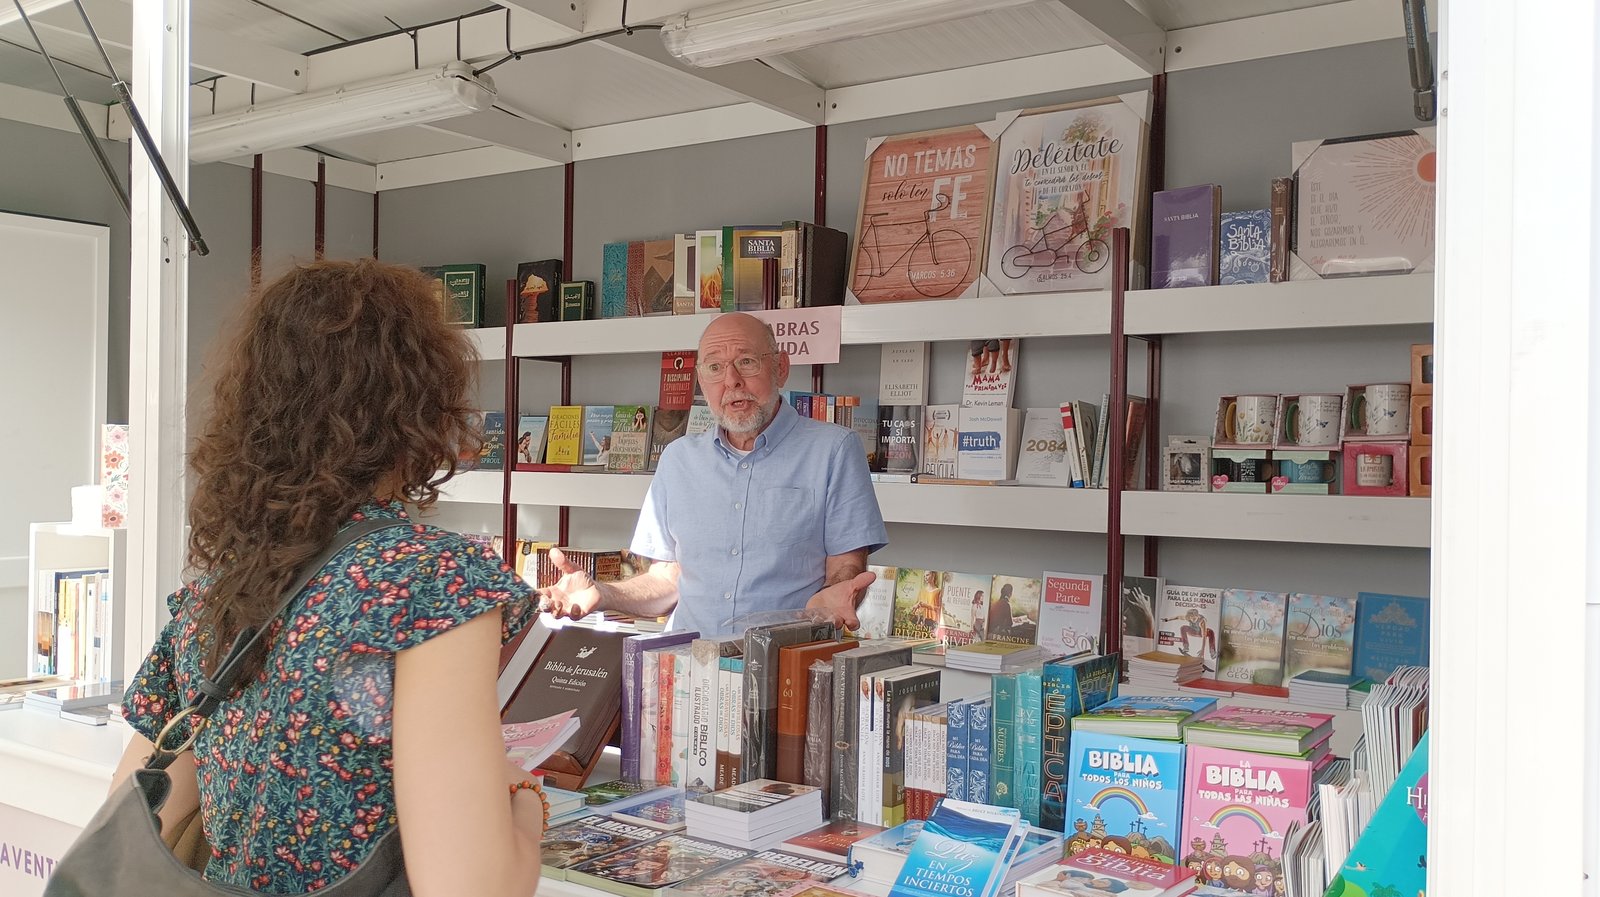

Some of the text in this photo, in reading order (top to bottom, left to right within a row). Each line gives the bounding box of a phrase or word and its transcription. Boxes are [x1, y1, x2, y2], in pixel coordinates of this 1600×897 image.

[884, 144, 976, 178] NO TEMAS
[1011, 136, 1123, 175] Deléitate
[929, 175, 972, 223] FE
[1180, 212, 1199, 221] BIBLIA
[882, 420, 893, 428] TU
[895, 427, 903, 436] SÍ
[881, 436, 916, 444] IMPORTA
[962, 435, 996, 447] #truth
[1026, 439, 1068, 452] 2084
[609, 461, 643, 470] GEORGE
[1048, 578, 1089, 592] Segunda
[947, 586, 972, 599] PUENTE
[1055, 592, 1080, 604] Parte
[1175, 601, 1207, 609] DECISIONES
[1193, 597, 1215, 605] BUENAS
[1224, 604, 1273, 632] Dios
[898, 623, 932, 633] FRANCINE
[1288, 610, 1342, 639] Dios
[895, 628, 936, 640] RIVERS
[993, 634, 1030, 644] FRANCINE
[544, 661, 567, 673] Biblia
[571, 664, 608, 679] Jerusalén
[551, 676, 587, 687] Quinta Edición
[1043, 681, 1071, 689] BIBLIA
[783, 688, 793, 698] 60
[693, 686, 702, 724] ILUSTRADO
[699, 678, 710, 767] DICCIONARIO BÍBLICO
[997, 727, 1005, 763] MUJERES
[1118, 744, 1129, 753] LA
[1088, 750, 1160, 777] BIBLIA
[1240, 759, 1251, 769] LA
[1113, 771, 1130, 779] PARA
[1205, 765, 1285, 793] BIBLIA
[1082, 773, 1163, 790] TODOS LOS NIÑOS
[1234, 788, 1253, 796] PARA
[1198, 789, 1290, 809] TODAS LAS NIÑAS
[578, 815, 604, 824] EL
[928, 860, 946, 870] EN
[1076, 854, 1167, 881] Biblia
[1114, 857, 1171, 873] primera
[915, 867, 971, 886] TIEMPOS
[904, 876, 973, 897] INCIERTOS
